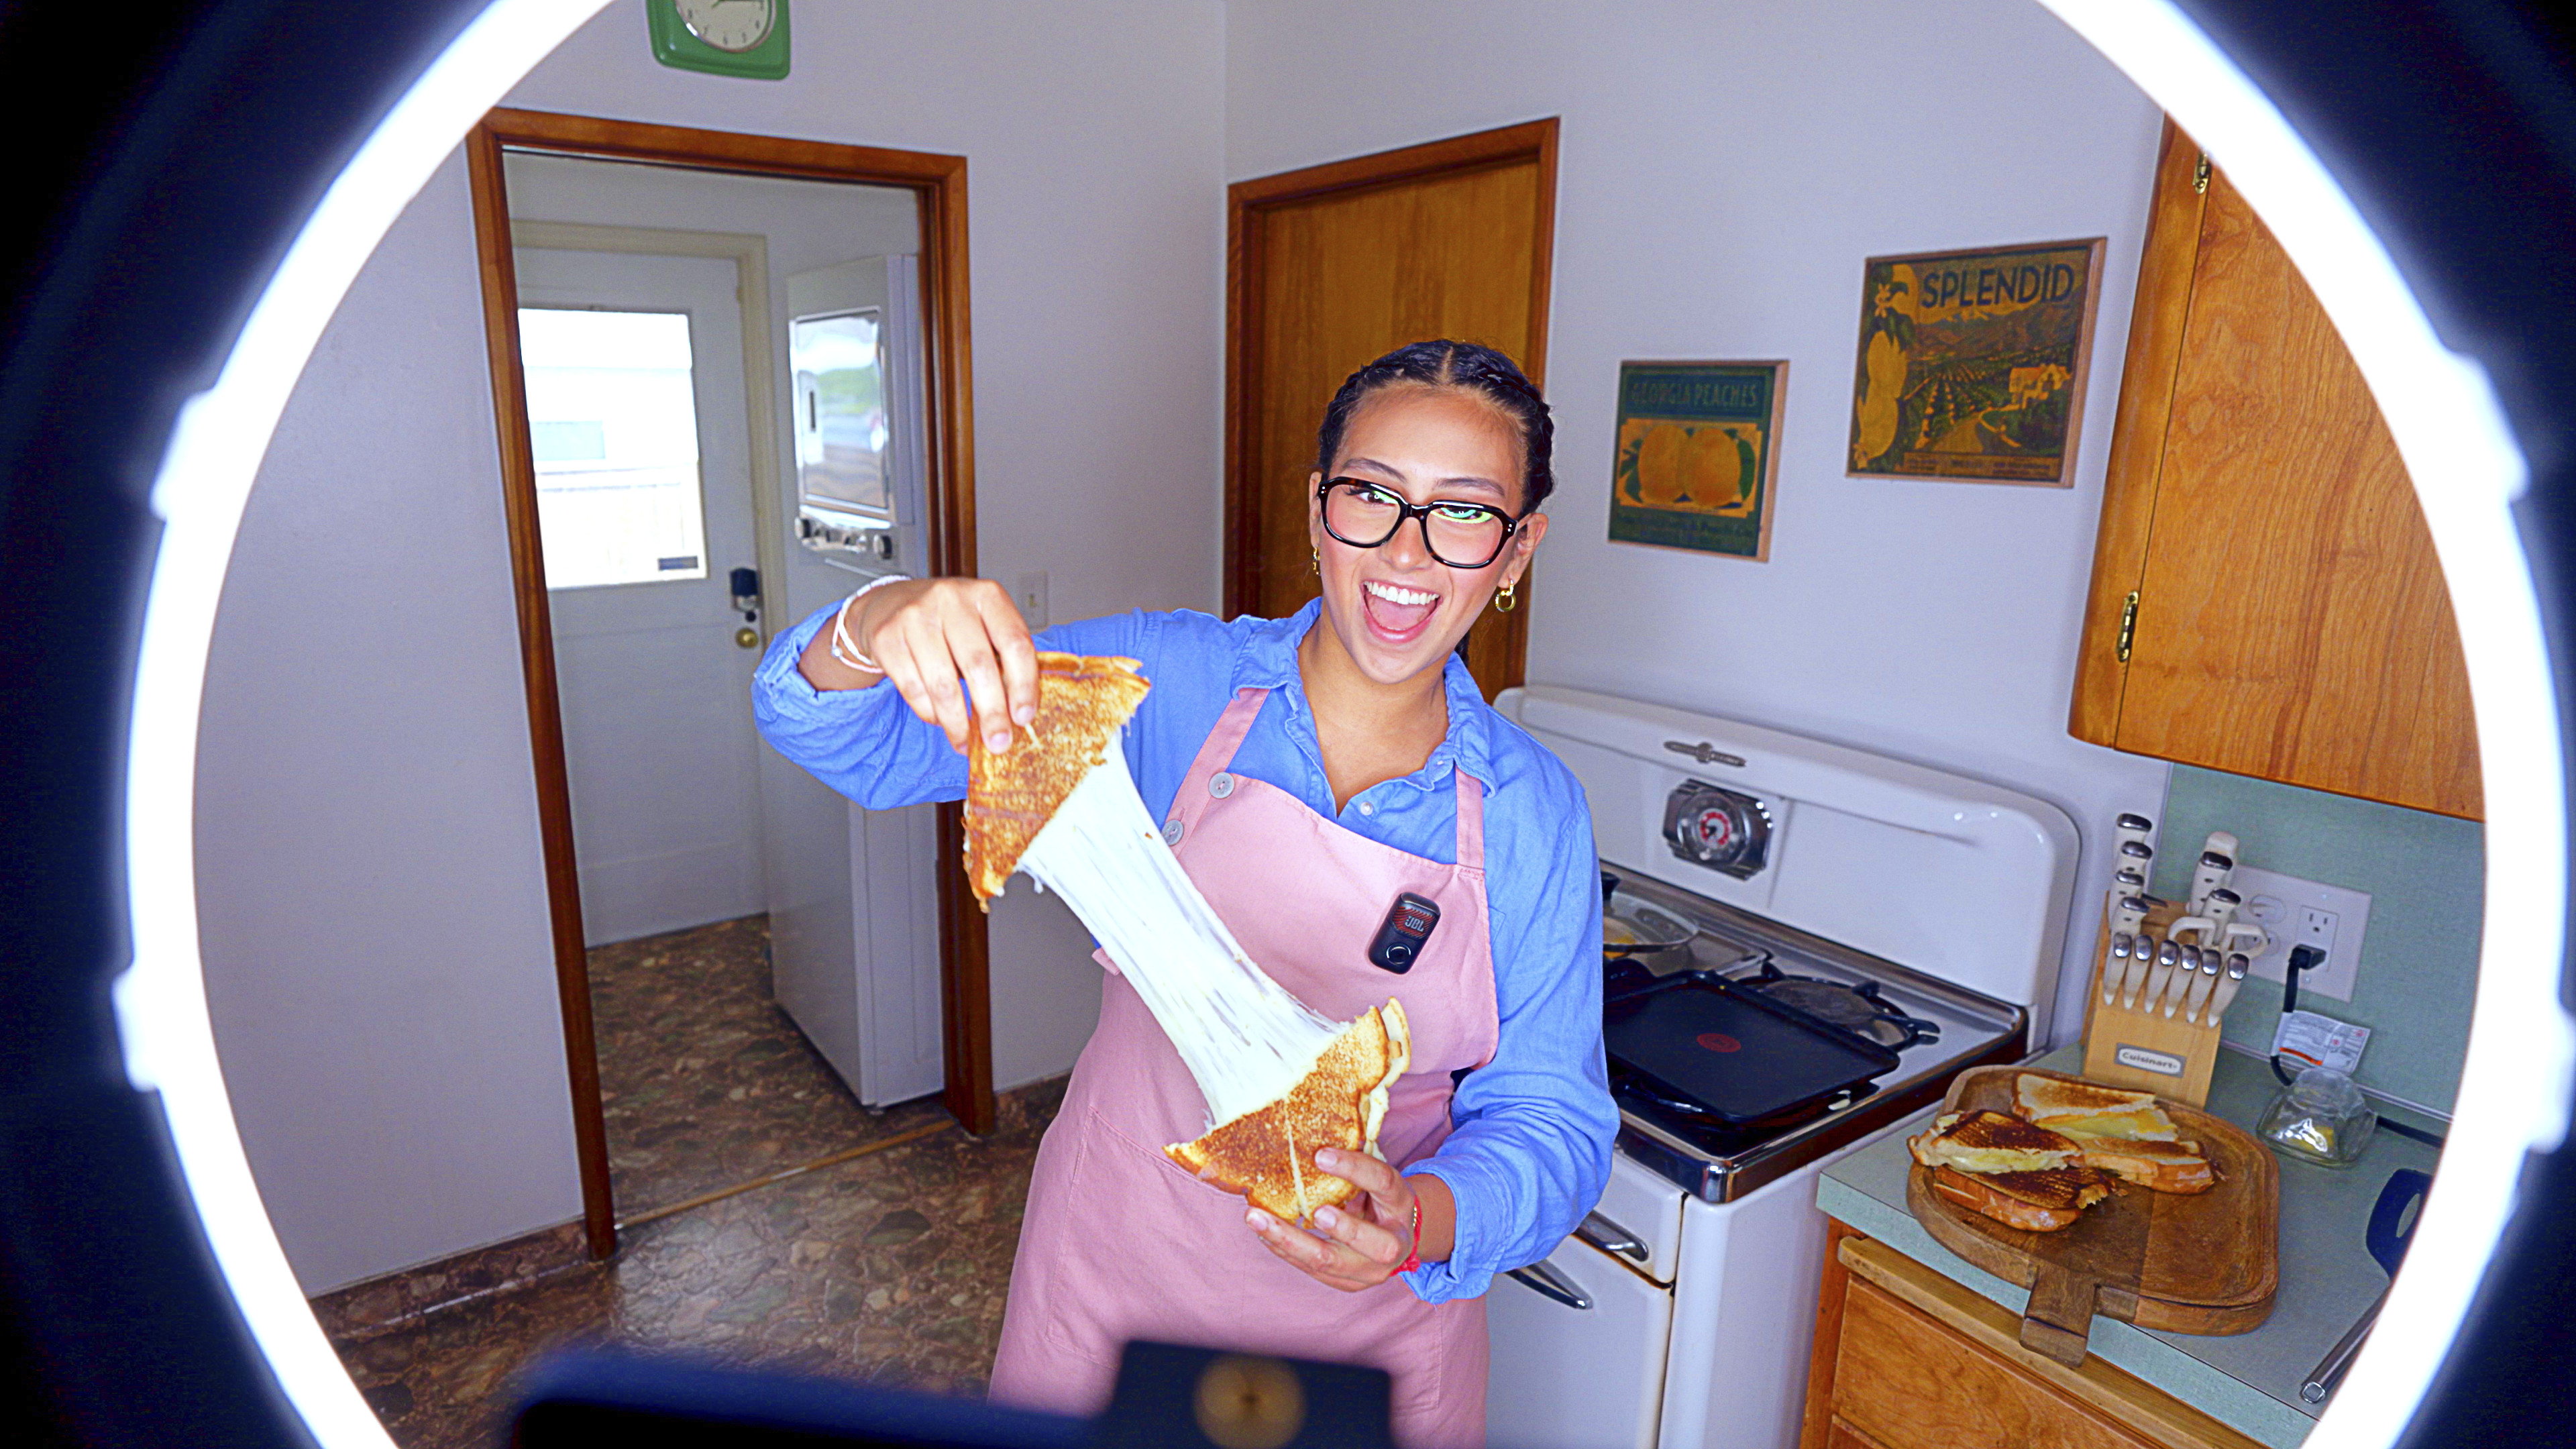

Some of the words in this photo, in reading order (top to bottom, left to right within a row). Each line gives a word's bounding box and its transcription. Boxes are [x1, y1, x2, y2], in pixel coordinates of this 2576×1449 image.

[1922, 264, 2074, 308] SPLENDID
[1694, 383, 1756, 407] PEACHES
[1405, 916, 1424, 932] JBL
[2123, 1052, 2174, 1068] Cuisinart
